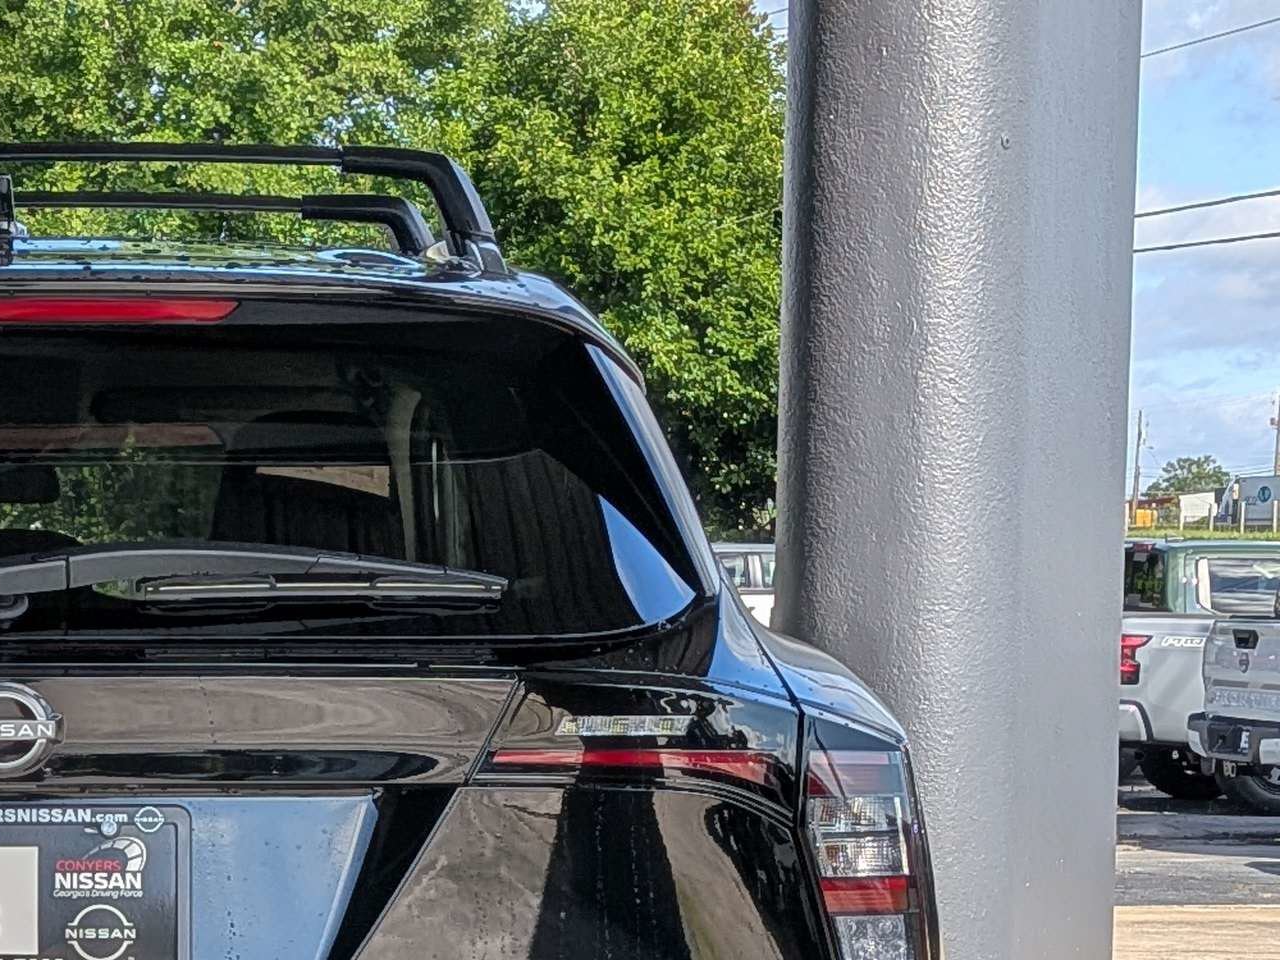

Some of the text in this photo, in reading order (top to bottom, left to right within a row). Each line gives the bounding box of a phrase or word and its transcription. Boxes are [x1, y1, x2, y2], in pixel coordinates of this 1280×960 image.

[55, 860, 121, 871] CONYERS
[54, 872, 142, 889] NISSAN
[91, 889, 119, 899] Driving
[120, 889, 144, 898] Force
[65, 928, 137, 939] NISSAN
